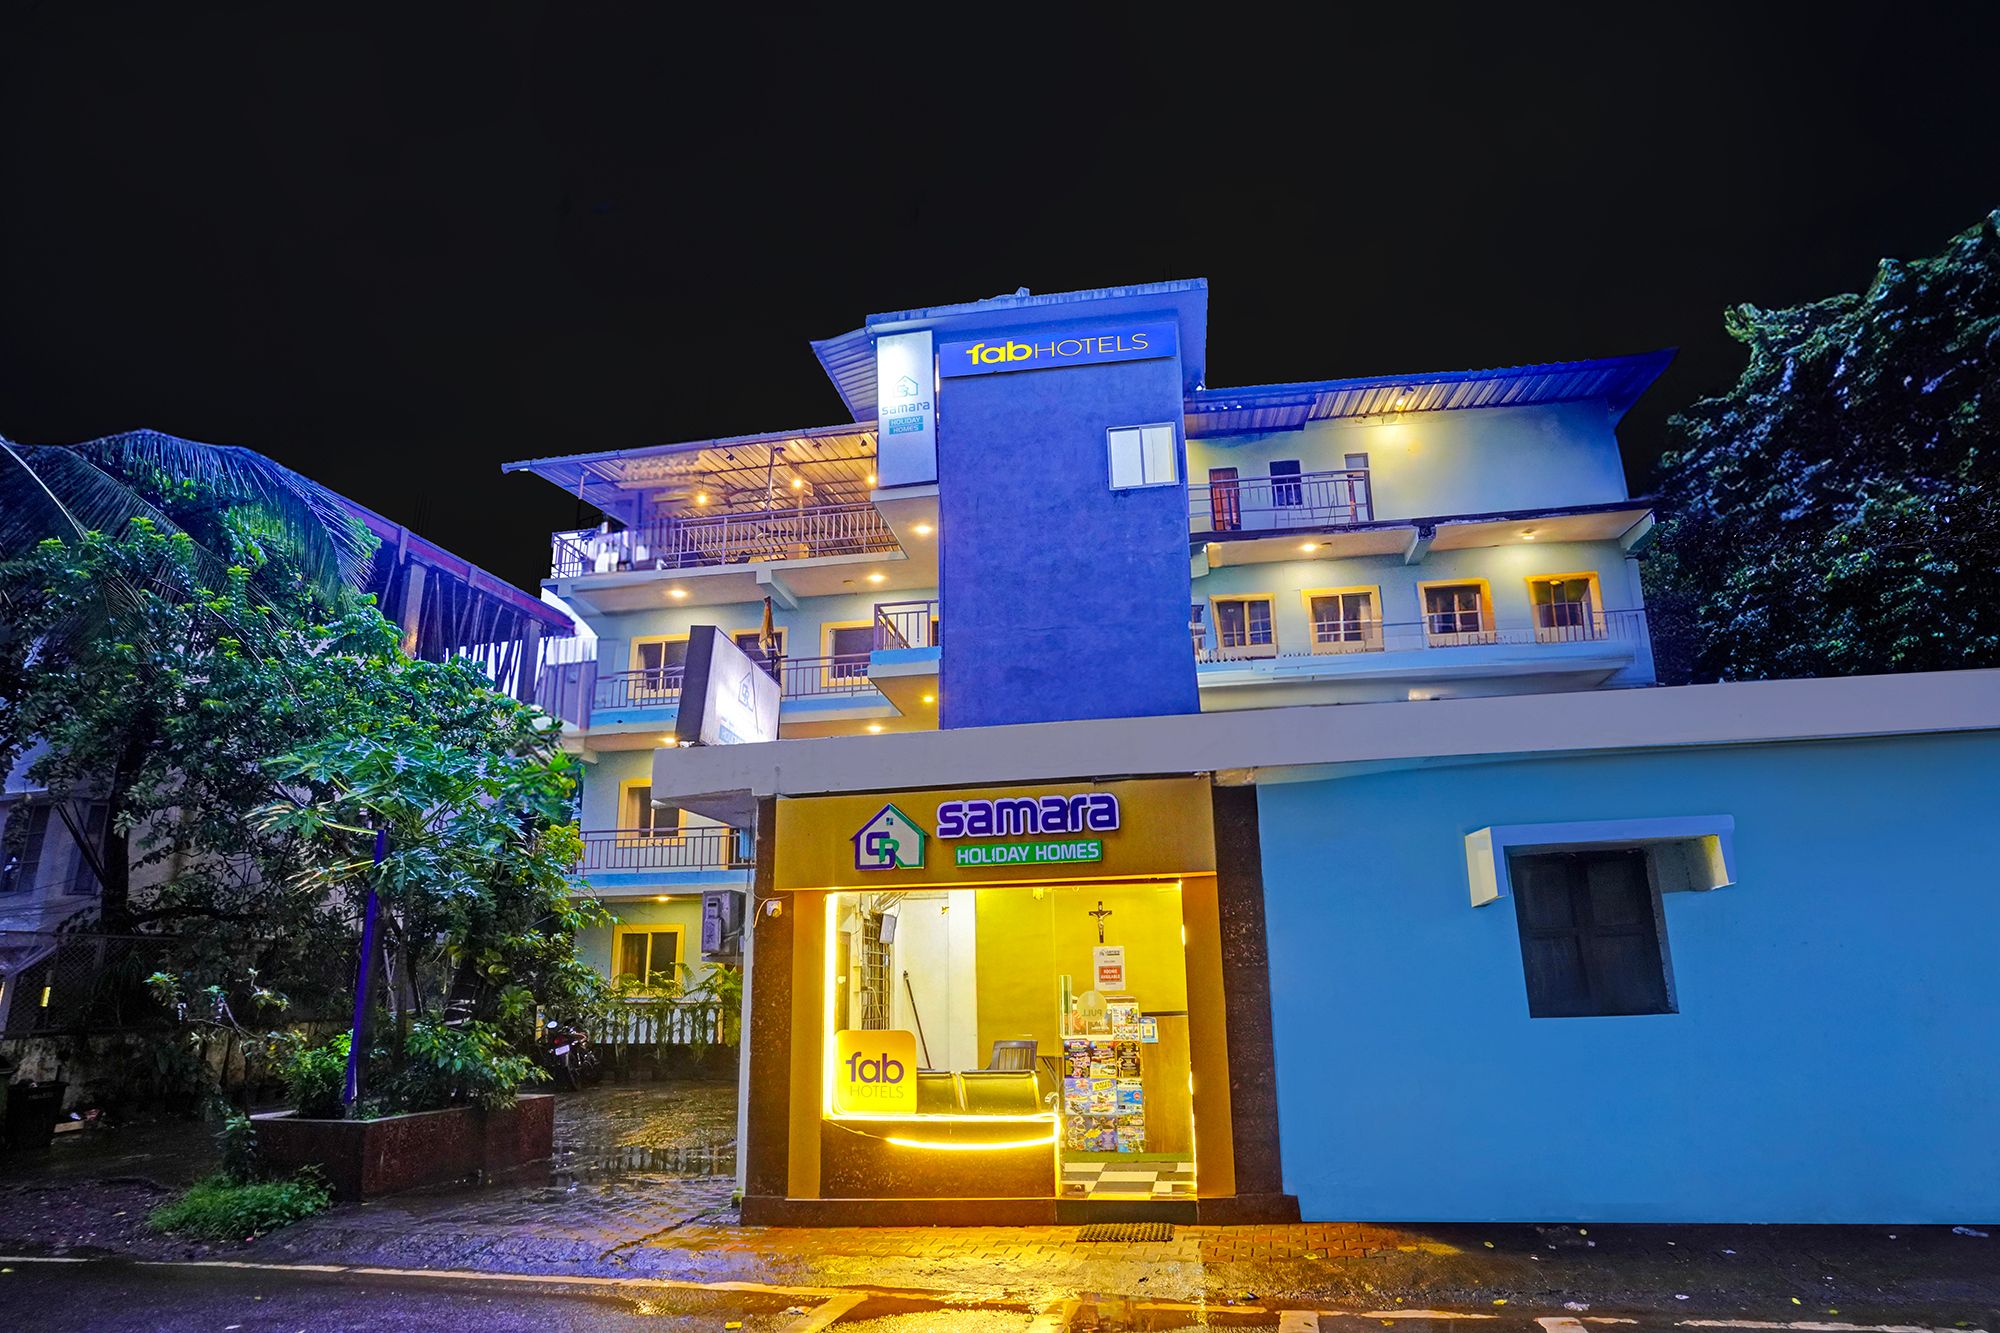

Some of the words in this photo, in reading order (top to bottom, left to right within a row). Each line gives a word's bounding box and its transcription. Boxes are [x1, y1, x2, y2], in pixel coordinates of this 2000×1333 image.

[881, 401, 930, 416] samara
[891, 416, 921, 426] HOLIDAY
[893, 424, 919, 434] HOMES
[936, 792, 1120, 839] samara
[957, 845, 1030, 865] HOLIDAY
[1035, 842, 1100, 861] HOMES
[845, 1051, 905, 1084] fab
[849, 1084, 905, 1099] HOTELS
